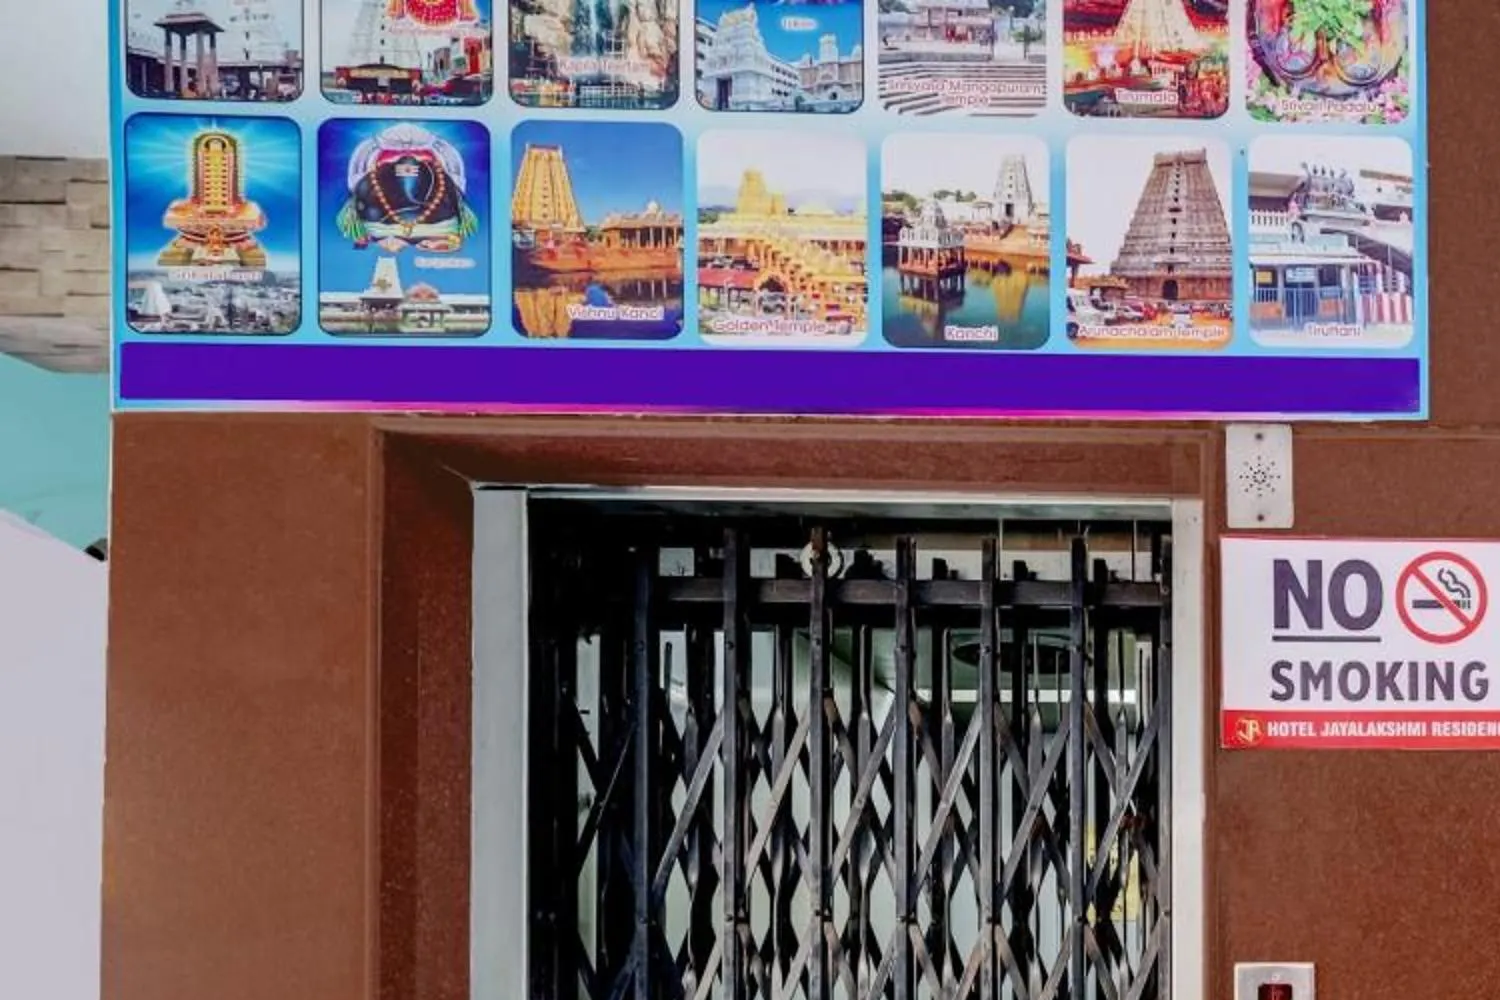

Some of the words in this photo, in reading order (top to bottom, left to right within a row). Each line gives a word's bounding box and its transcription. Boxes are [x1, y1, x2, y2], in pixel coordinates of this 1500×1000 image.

[713, 319, 769, 332] Golden
[772, 319, 827, 335] Temple
[947, 325, 998, 339] Kanchi
[1079, 324, 1173, 338] Arunachalam
[1272, 558, 1384, 631] NO
[1269, 659, 1490, 703] SMOKING
[1267, 720, 1317, 737] HOTEL
[1320, 720, 1427, 737] JAYALAKSHMI
